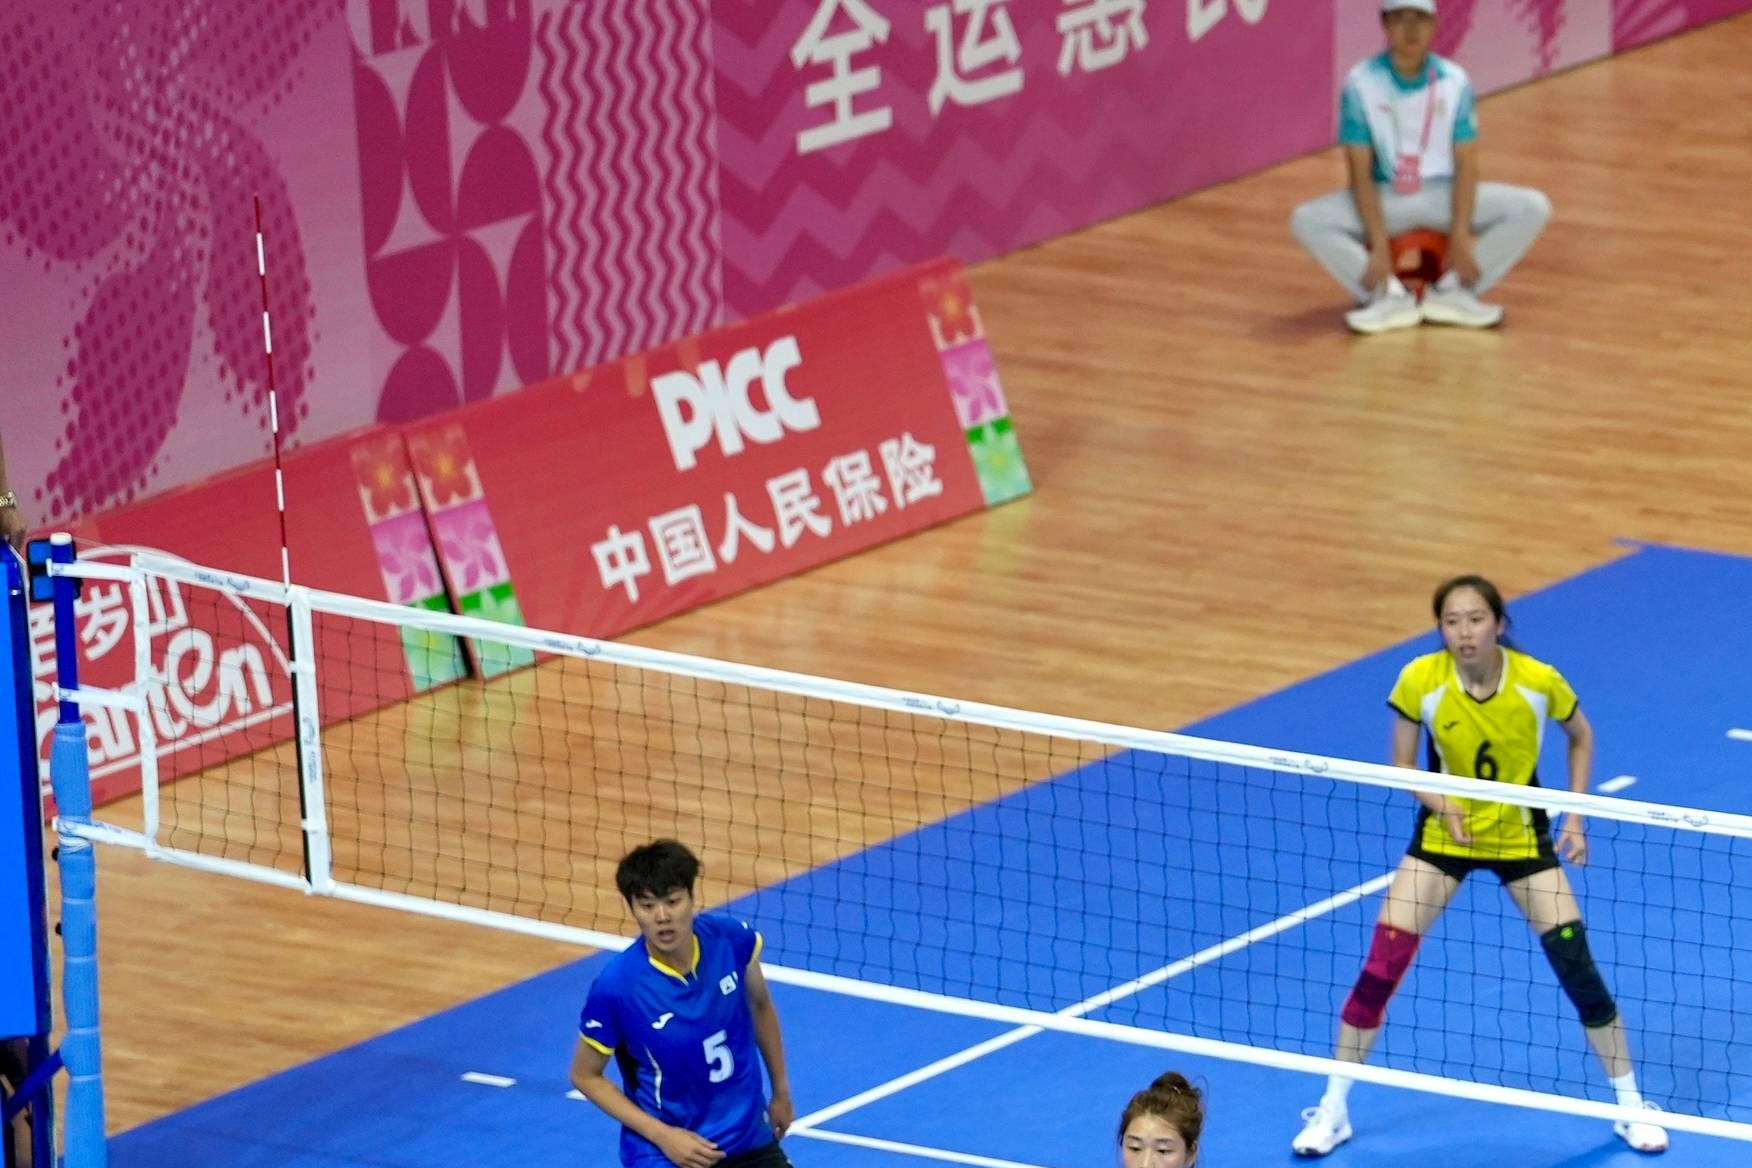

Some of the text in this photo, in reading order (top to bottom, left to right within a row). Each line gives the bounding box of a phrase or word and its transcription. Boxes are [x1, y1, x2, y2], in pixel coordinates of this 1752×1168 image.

[651, 335, 821, 472] PICC
[591, 431, 943, 603] 中国人民保险
[1475, 739, 1499, 781] 6
[702, 1029, 735, 1083] 5
